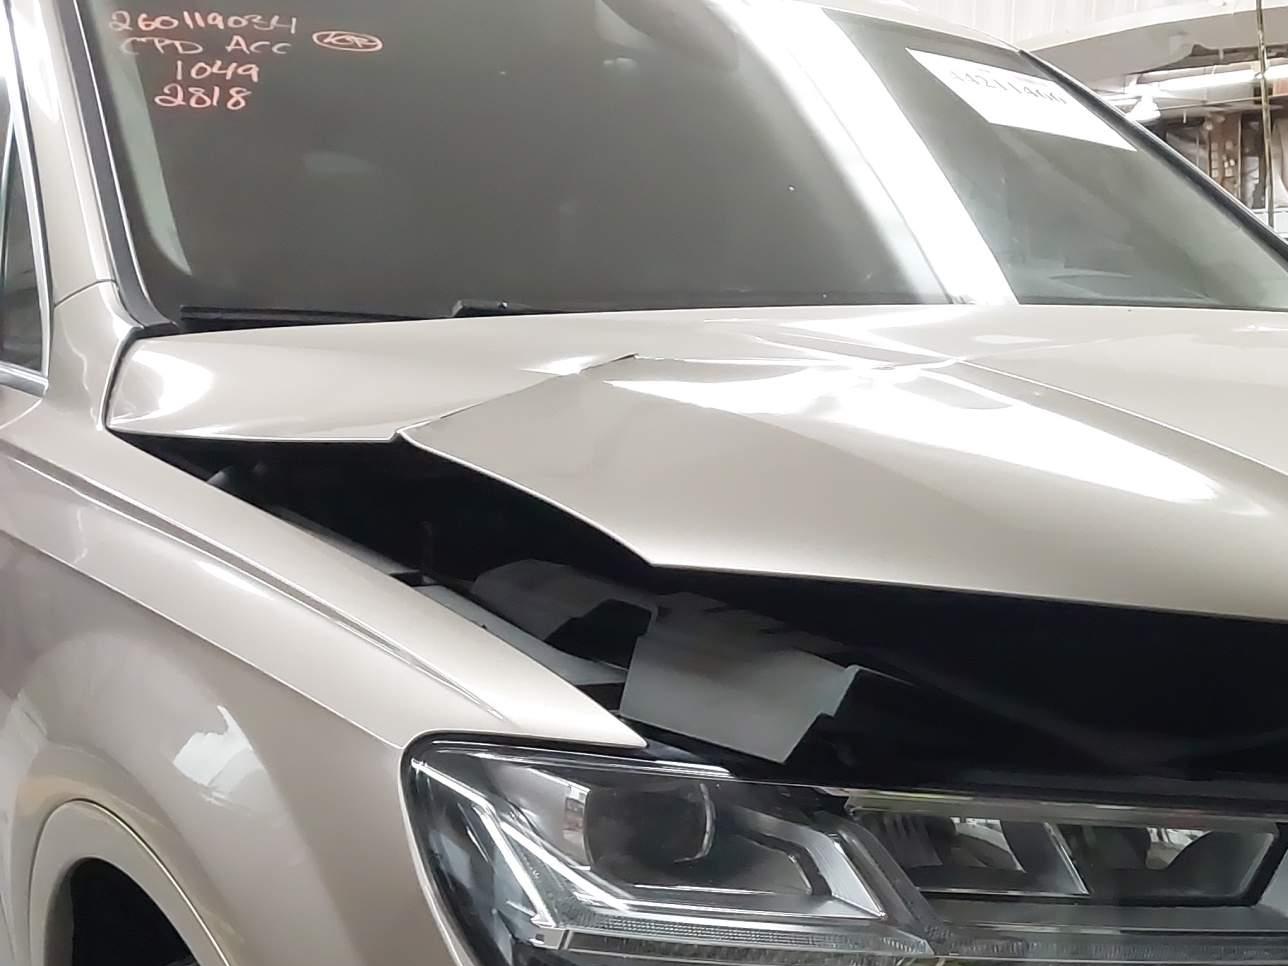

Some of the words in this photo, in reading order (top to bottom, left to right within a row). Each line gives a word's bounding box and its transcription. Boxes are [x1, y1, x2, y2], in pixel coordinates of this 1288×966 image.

[108, 10, 297, 34] 260119034
[176, 60, 260, 82] 1049
[154, 83, 251, 110] 2818
